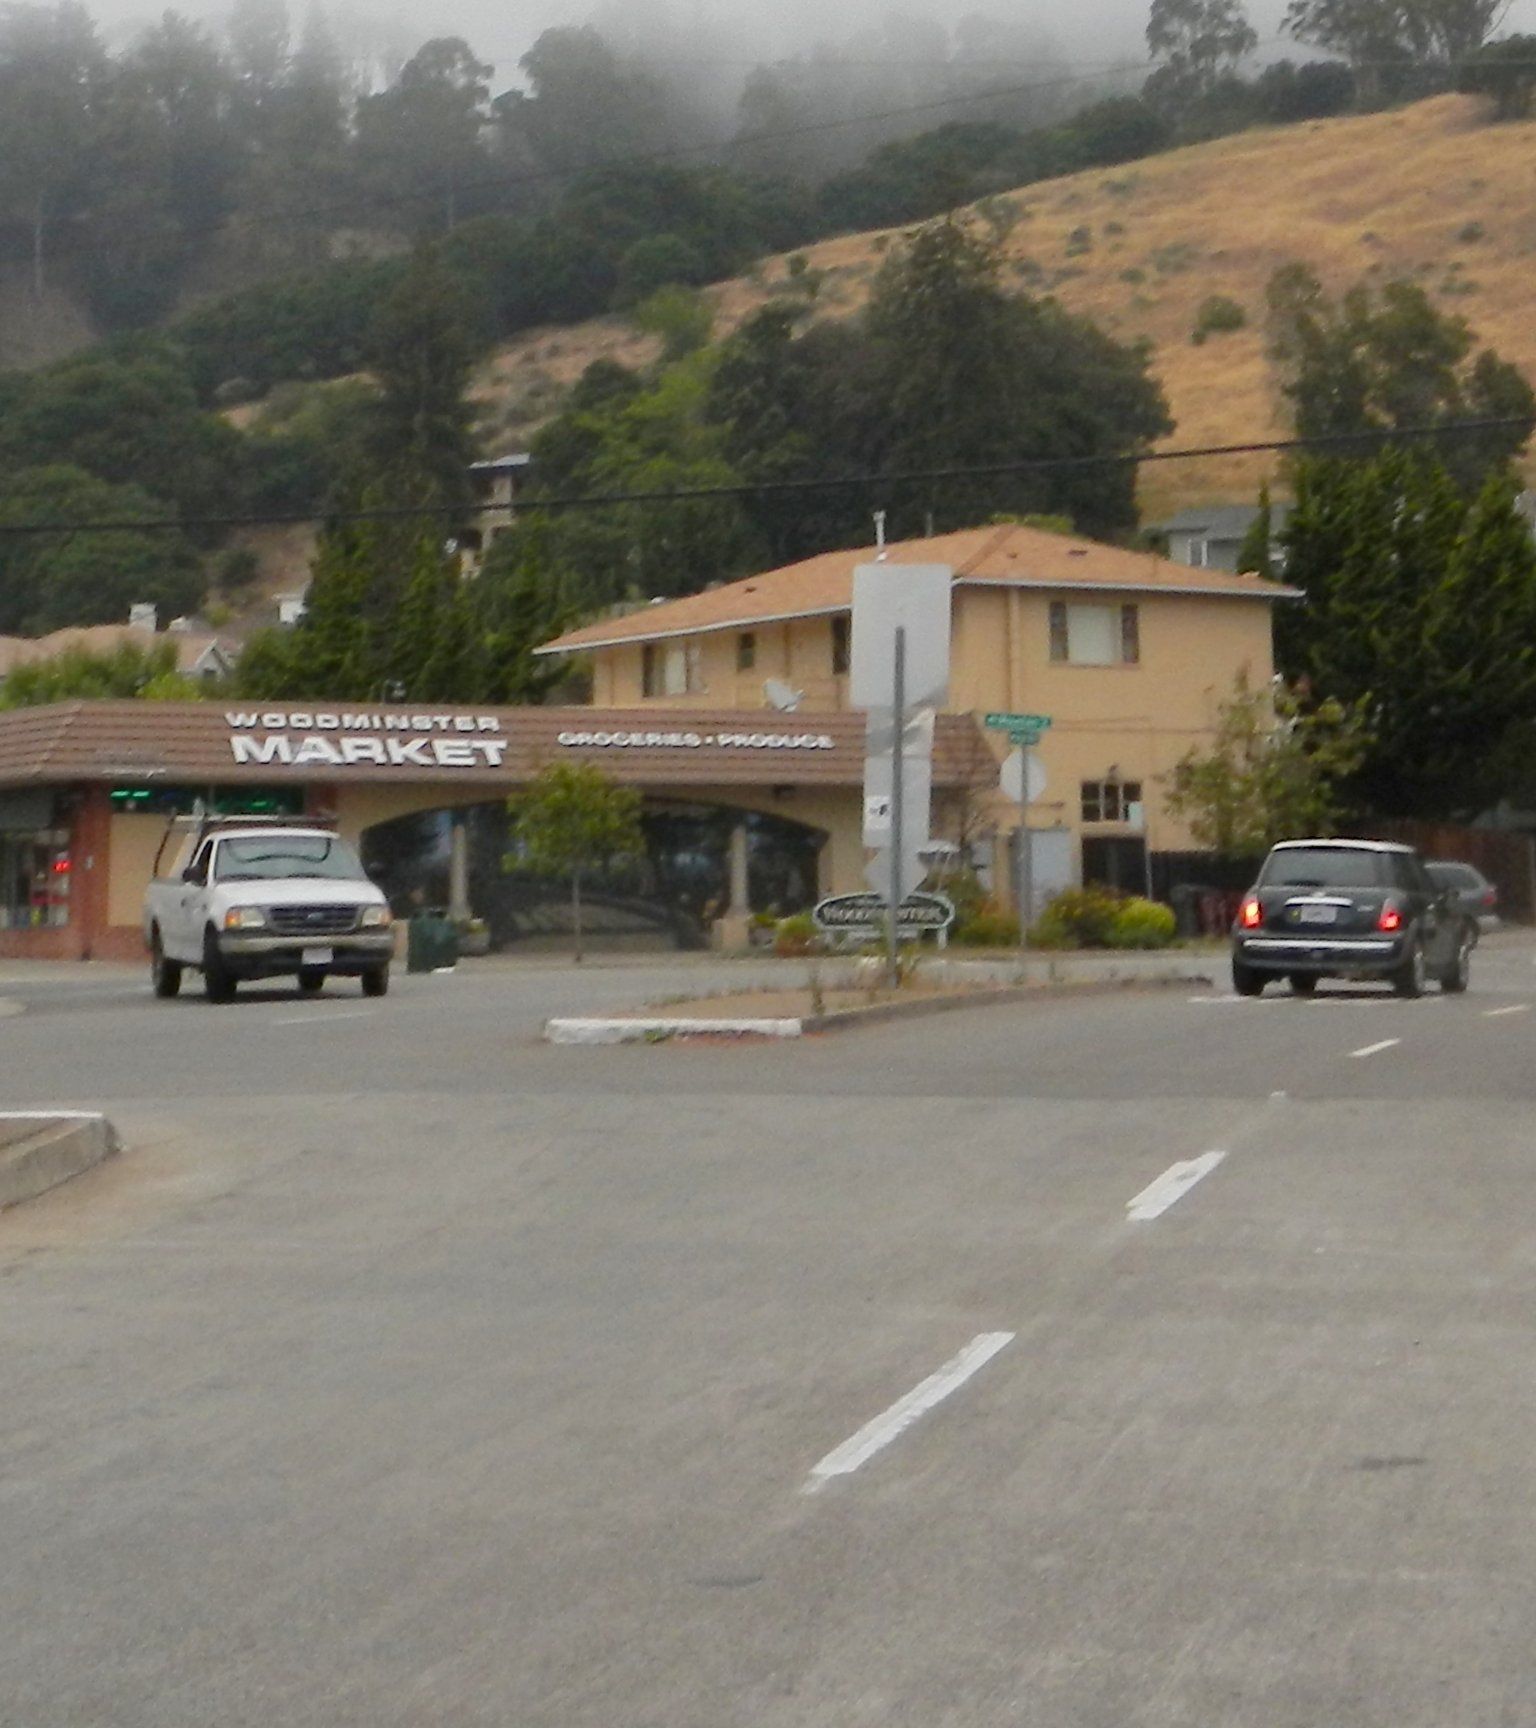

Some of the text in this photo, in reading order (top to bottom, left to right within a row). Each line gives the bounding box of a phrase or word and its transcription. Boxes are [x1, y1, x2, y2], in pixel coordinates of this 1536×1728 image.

[224, 712, 500, 732] WOODMINSTER
[558, 731, 835, 750] GROCERIES PRODUCE
[230, 735, 508, 767] MARKET
